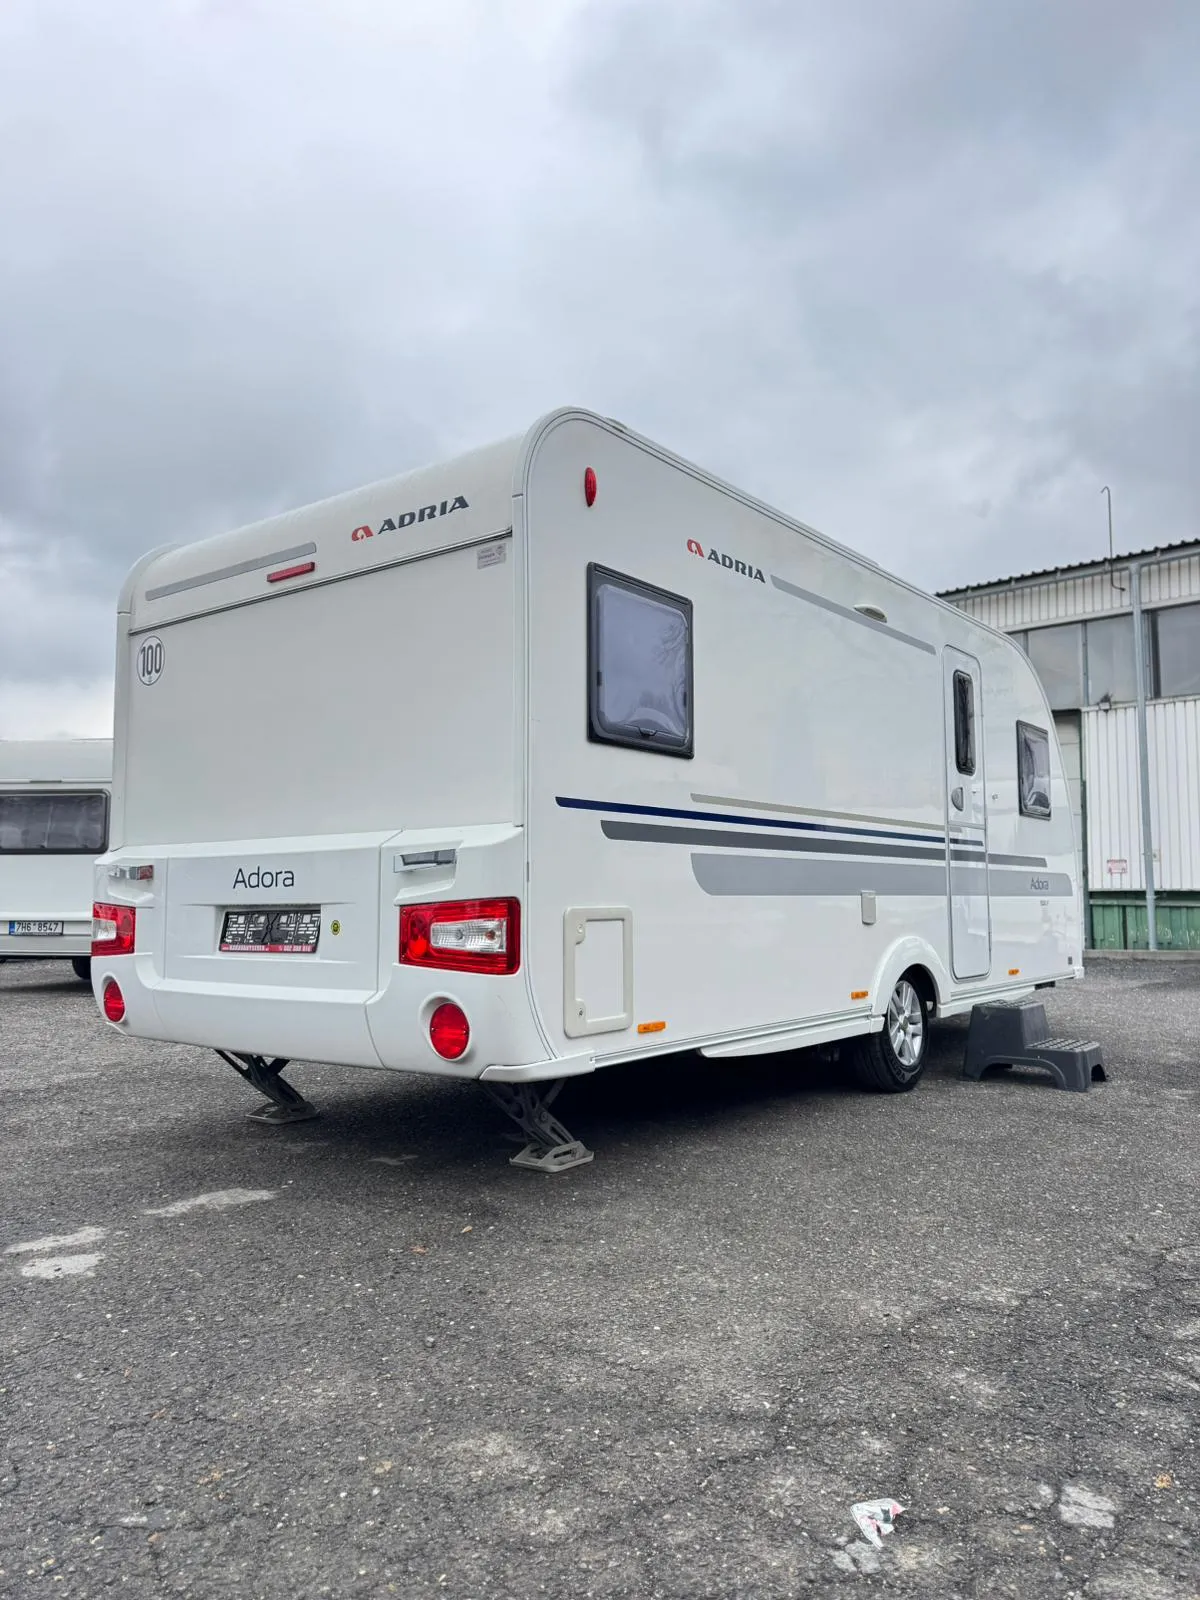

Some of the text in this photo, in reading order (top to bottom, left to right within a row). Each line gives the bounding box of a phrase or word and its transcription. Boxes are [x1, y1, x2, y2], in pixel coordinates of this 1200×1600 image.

[378, 496, 469, 534] ADRIA
[707, 548, 766, 584] ADRIA
[141, 643, 162, 677] 100
[233, 866, 294, 889] Adora
